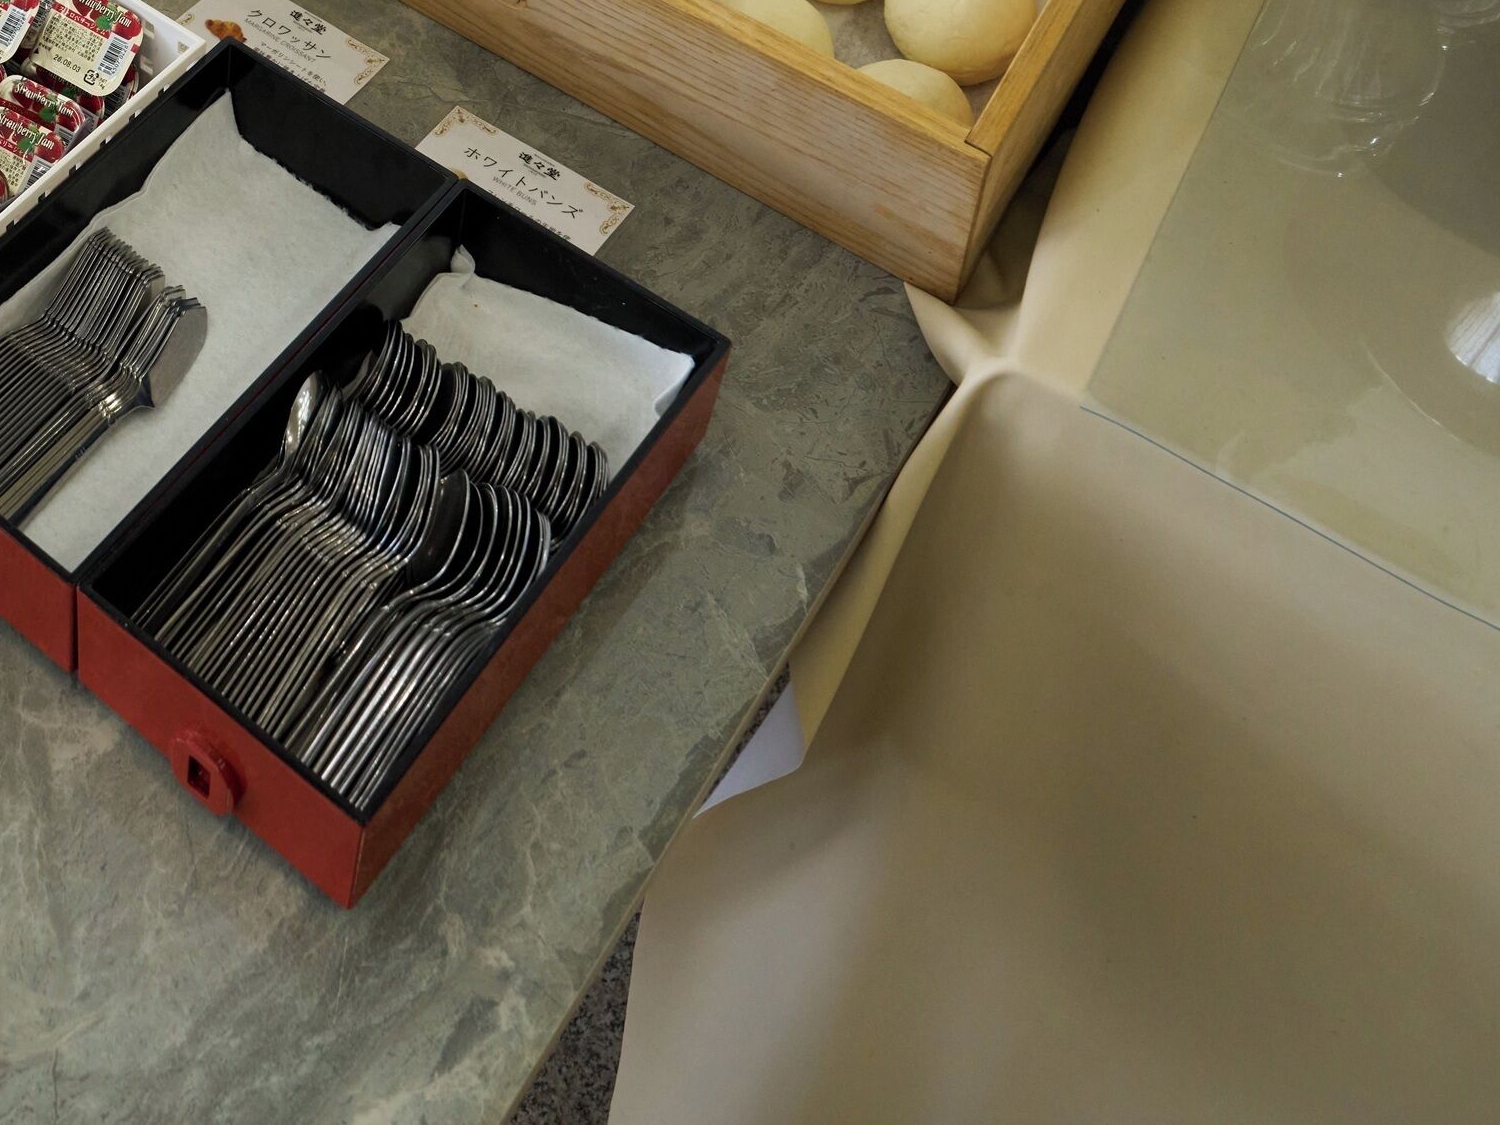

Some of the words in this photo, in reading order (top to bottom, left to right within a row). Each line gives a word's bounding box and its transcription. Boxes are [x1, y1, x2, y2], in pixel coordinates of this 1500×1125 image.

[113, 10, 132, 28] Jam
[247, 9, 332, 60] クロワッサン
[280, 40, 317, 64] CROISSANT
[53, 53, 82, 74] 26.08.03
[57, 98, 74, 117] Jam
[36, 132, 55, 150] Jam
[463, 147, 583, 219] ホワイトバンズ
[492, 175, 517, 195] WHITE
[515, 189, 538, 206] BUNS
